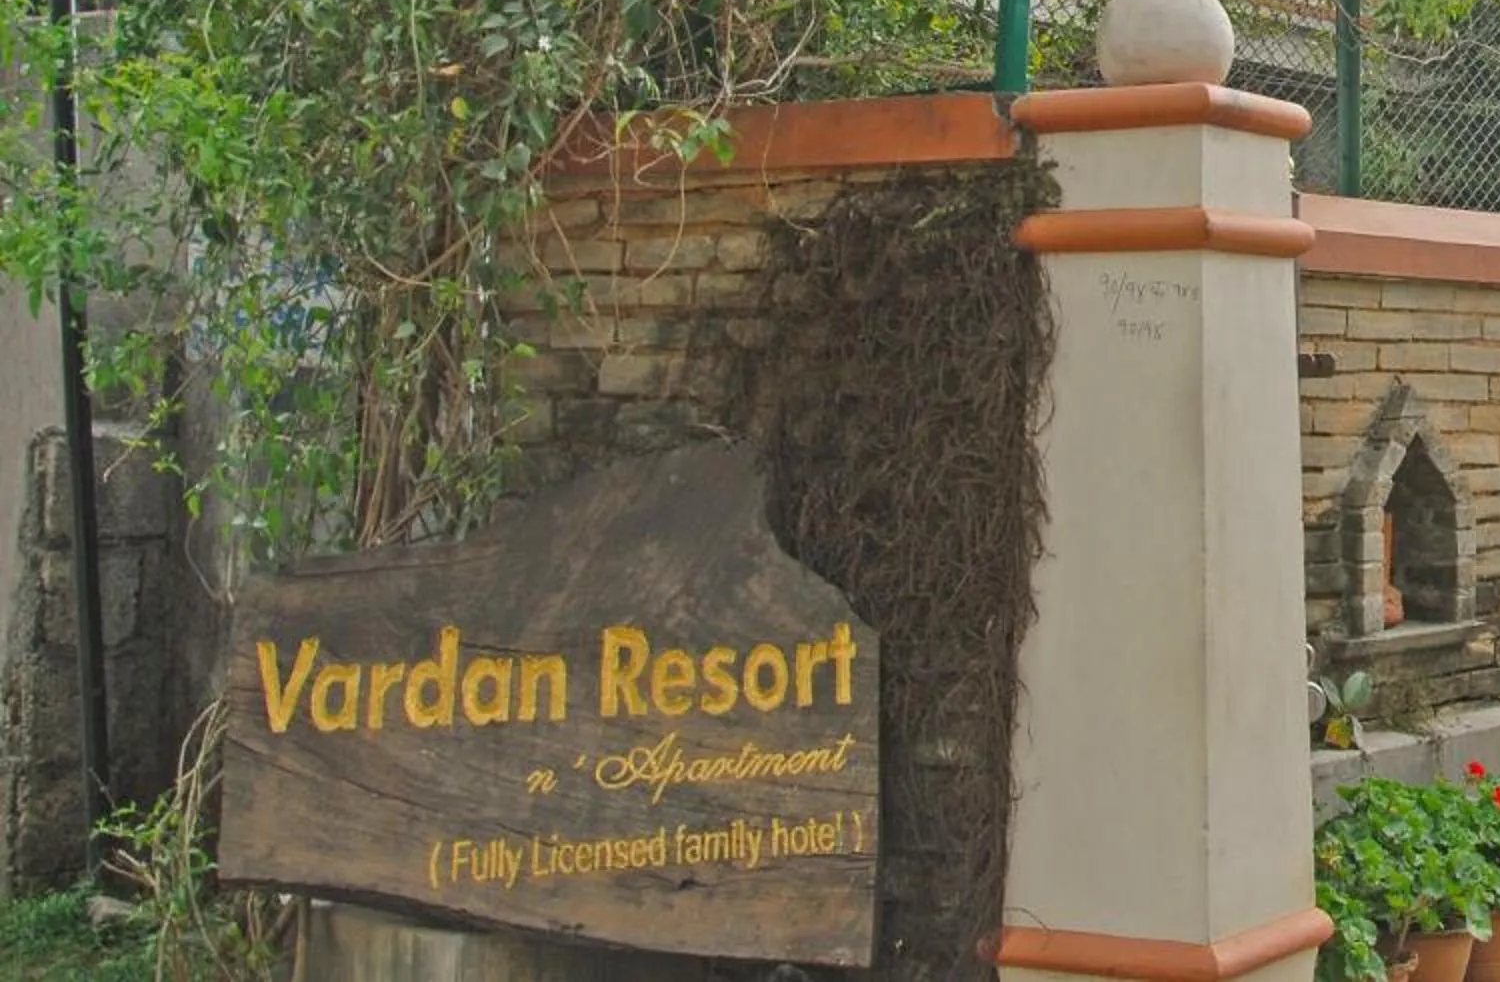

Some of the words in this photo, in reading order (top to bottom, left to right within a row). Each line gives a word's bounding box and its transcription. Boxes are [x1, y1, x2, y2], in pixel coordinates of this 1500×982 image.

[256, 624, 568, 734] Vardan
[599, 621, 858, 718] Resort
[595, 729, 856, 805] Apartment
[531, 826, 667, 877] Licensed
[674, 818, 764, 869] family
